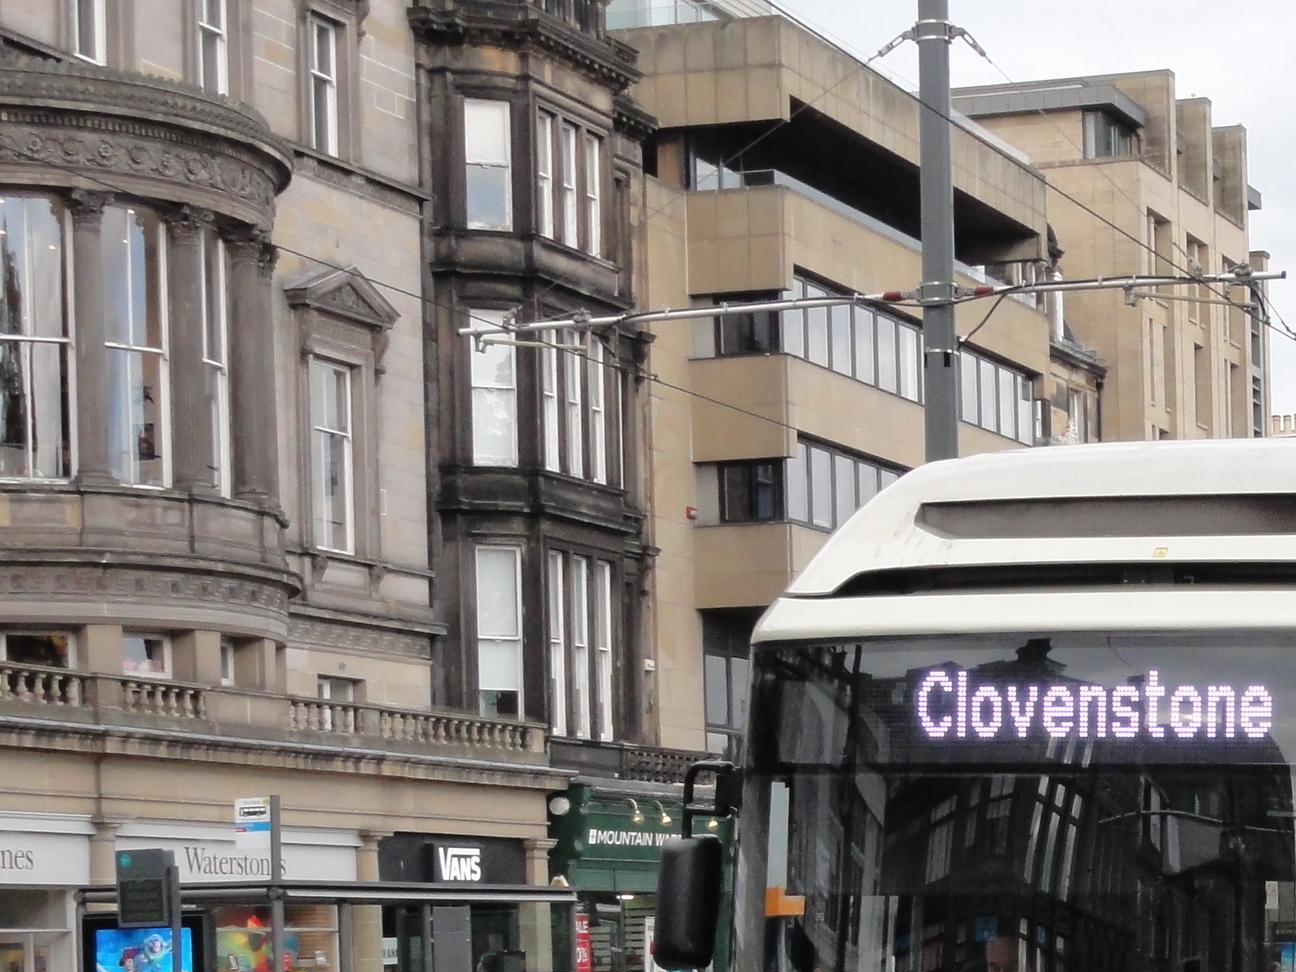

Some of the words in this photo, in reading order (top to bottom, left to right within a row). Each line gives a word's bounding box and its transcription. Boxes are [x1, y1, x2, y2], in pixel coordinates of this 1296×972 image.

[918, 671, 1272, 738] Clovenstone
[597, 830, 652, 846] MOUNTAIN
[185, 846, 287, 877] Waterstons
[438, 847, 481, 881] VANS
